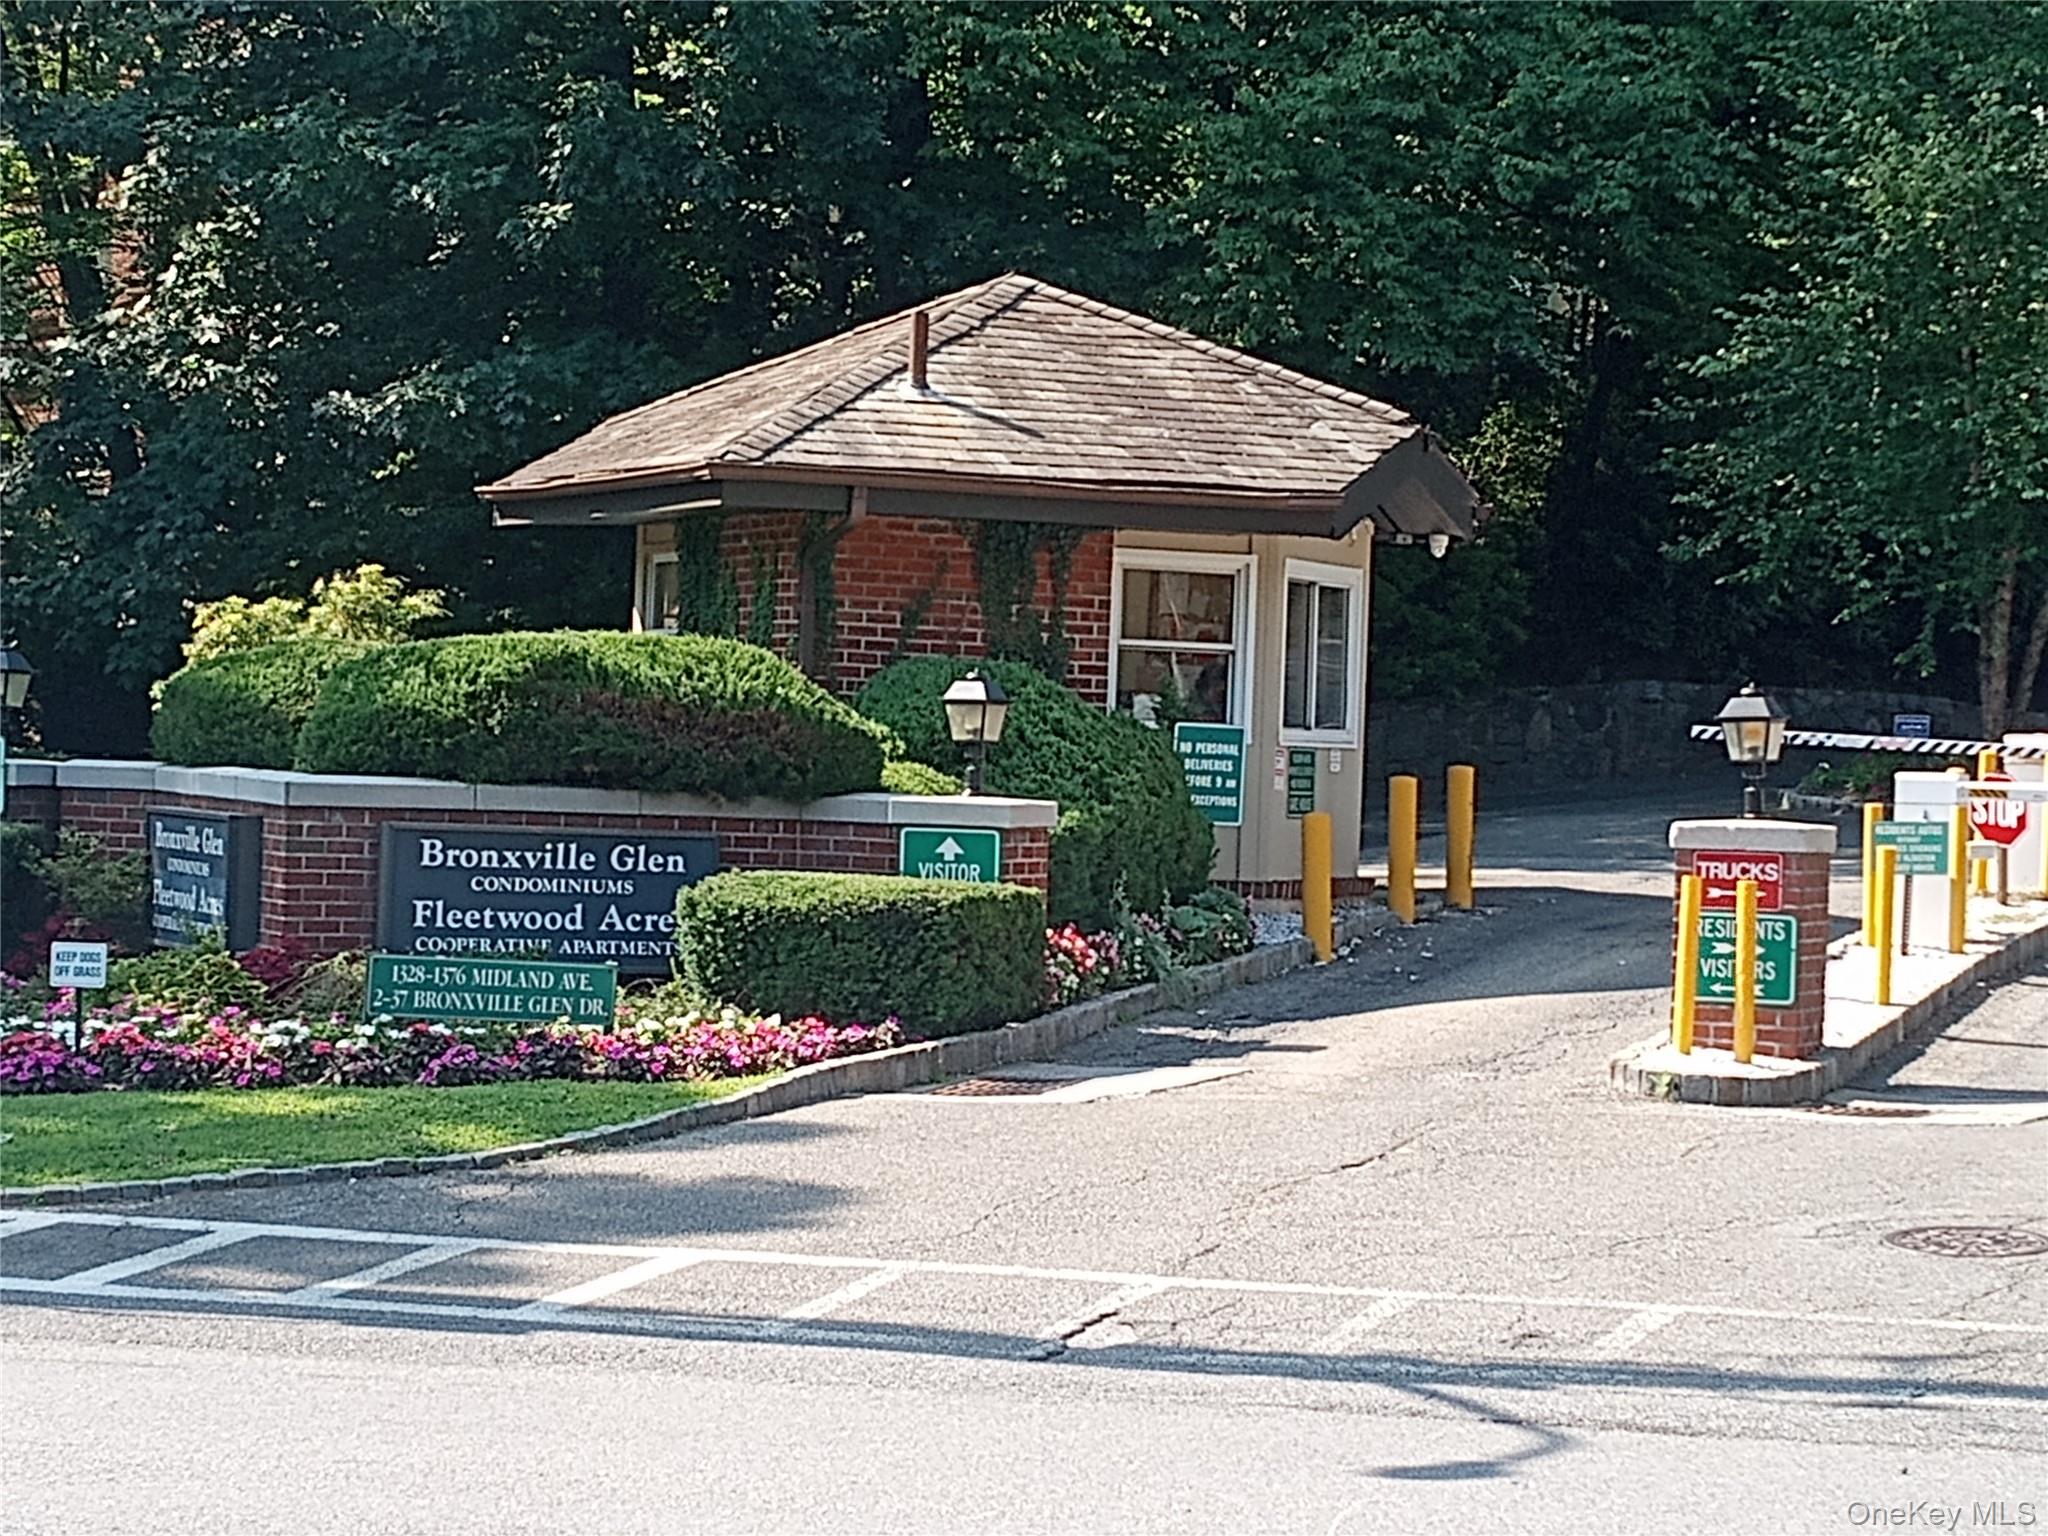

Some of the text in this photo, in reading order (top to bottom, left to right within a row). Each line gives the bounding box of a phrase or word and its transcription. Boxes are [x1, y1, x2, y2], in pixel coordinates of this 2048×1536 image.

[1195, 741, 1239, 756] PERSONAL
[1184, 758, 1233, 772] DELIVERIES
[1971, 799, 2026, 829] STOP
[202, 827, 224, 856] Glen
[420, 838, 687, 873] Bronxville Glen
[918, 862, 981, 884] VISITOR
[1697, 861, 1780, 881] TRUCKS
[471, 876, 635, 895] CONDOMINIUMS
[412, 899, 675, 933] Fleetwood Acre
[415, 936, 552, 953] COOPERATIVE
[56, 951, 101, 963] KEEP DOGS
[54, 965, 102, 977] OFF GRASS
[391, 964, 593, 991] 1328-1376 MIDLAND AVE.
[1700, 958, 1777, 980] VISIRS
[372, 988, 609, 1017] 2-37 BRONXVILLE GLEN DR.
